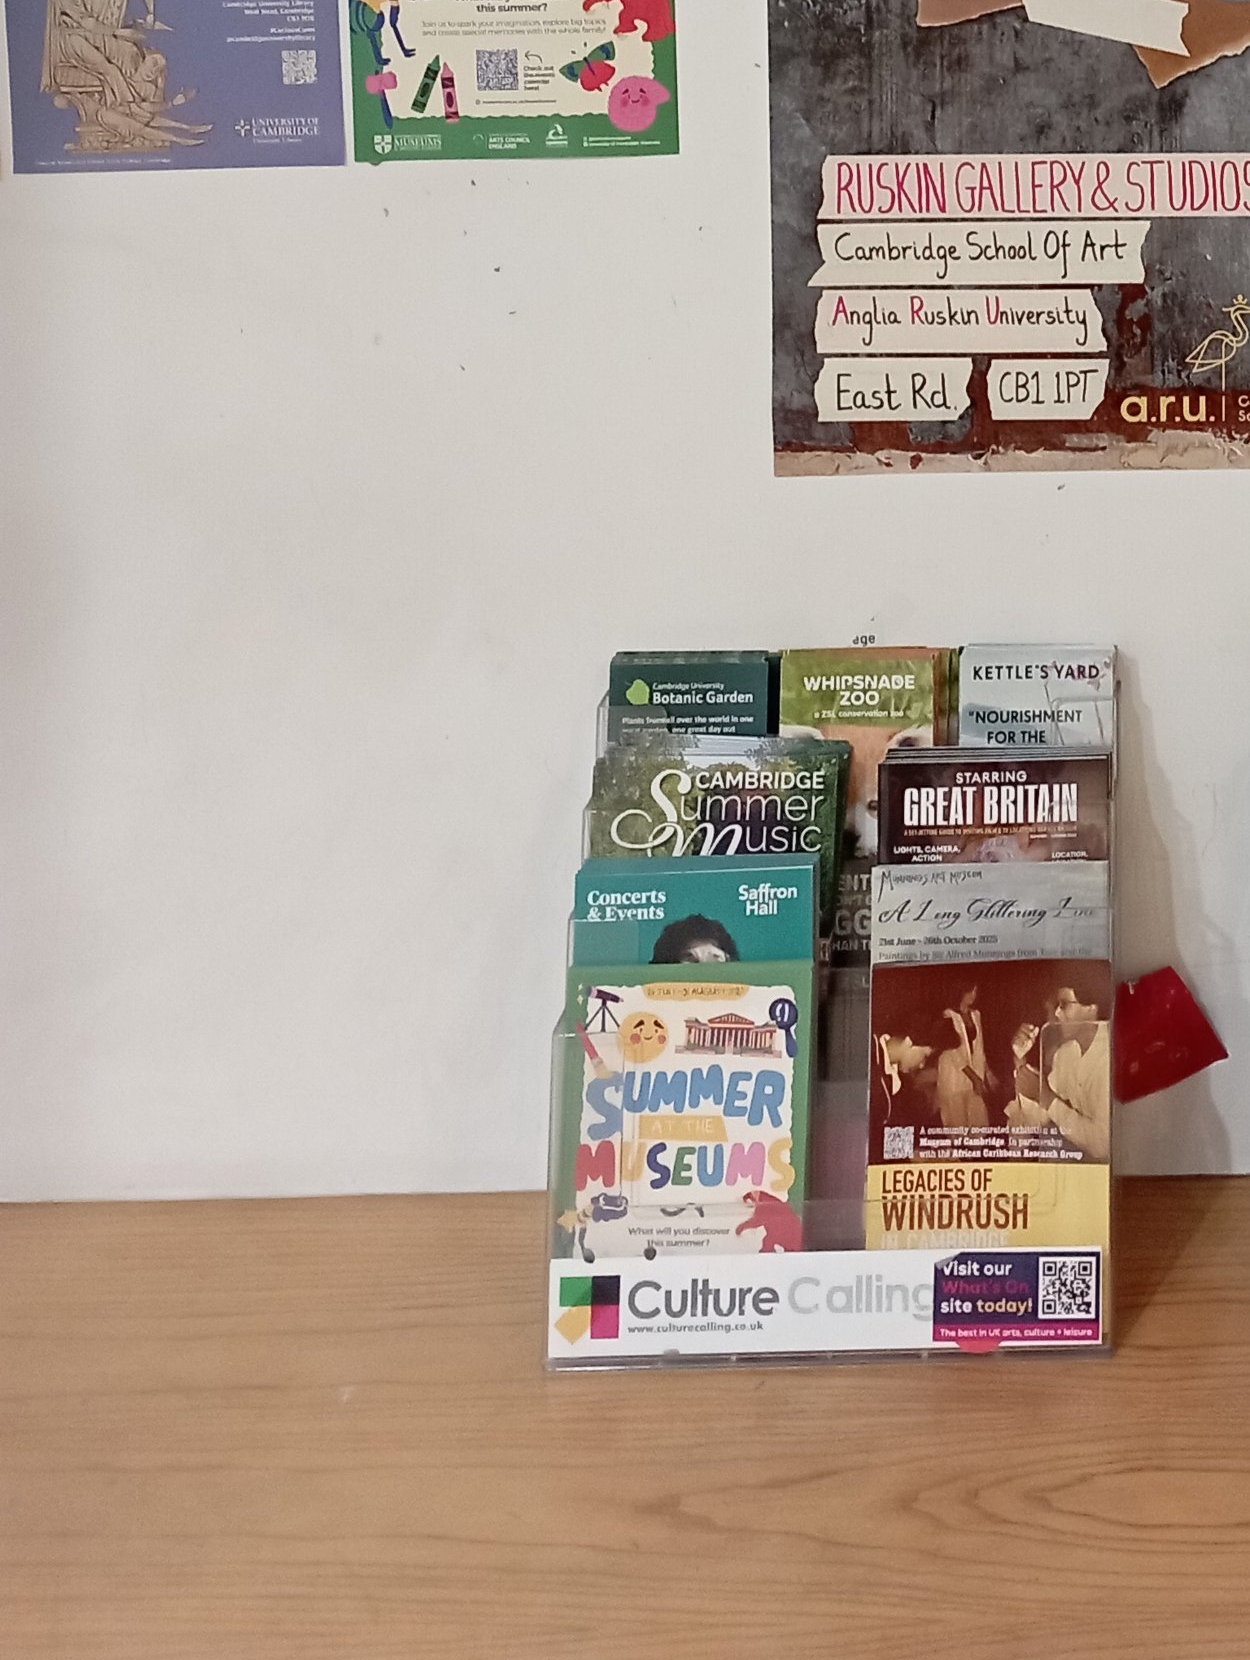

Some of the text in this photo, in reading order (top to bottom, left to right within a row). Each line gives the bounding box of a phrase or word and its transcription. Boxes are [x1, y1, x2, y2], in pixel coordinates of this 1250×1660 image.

[477, 3, 547, 12] this summer?
[836, 162, 947, 214] RUSKIN
[955, 160, 1086, 213] GALLERY
[1090, 161, 1119, 212] &
[834, 230, 1127, 278] Cambridge School Of Art
[832, 295, 1089, 346] Anglia Ruskin University
[836, 373, 958, 411] East Rd.
[1000, 369, 1100, 404] CB1 1PT
[1120, 395, 1216, 423] a.r.u.
[803, 674, 915, 691] WHIPSNADE
[973, 664, 1099, 680] KETTLE'S YARD
[653, 691, 753, 704] Botanic Garden
[840, 690, 880, 706] ZOO
[968, 710, 1082, 725] "NOURISHMENT
[987, 730, 1046, 744] FOR THE
[696, 771, 824, 789] CAMBRIDGE
[956, 771, 1027, 784] STARRING
[904, 783, 1077, 826] GREAT BRITAIN
[649, 823, 822, 858] Music
[587, 883, 797, 906] Concerts Saffron
[587, 900, 777, 920] & Events Hall
[585, 1064, 785, 1141] SUMMER
[574, 1138, 795, 1192] MUSEUMS
[882, 1168, 993, 1194] LEGACIES OF
[882, 1193, 1029, 1231] WINDRUSH
[943, 1260, 1012, 1276] Visit our
[628, 1274, 933, 1321] Culture Calling
[943, 1280, 1000, 1294] What's
[940, 1298, 1033, 1316] site today!
